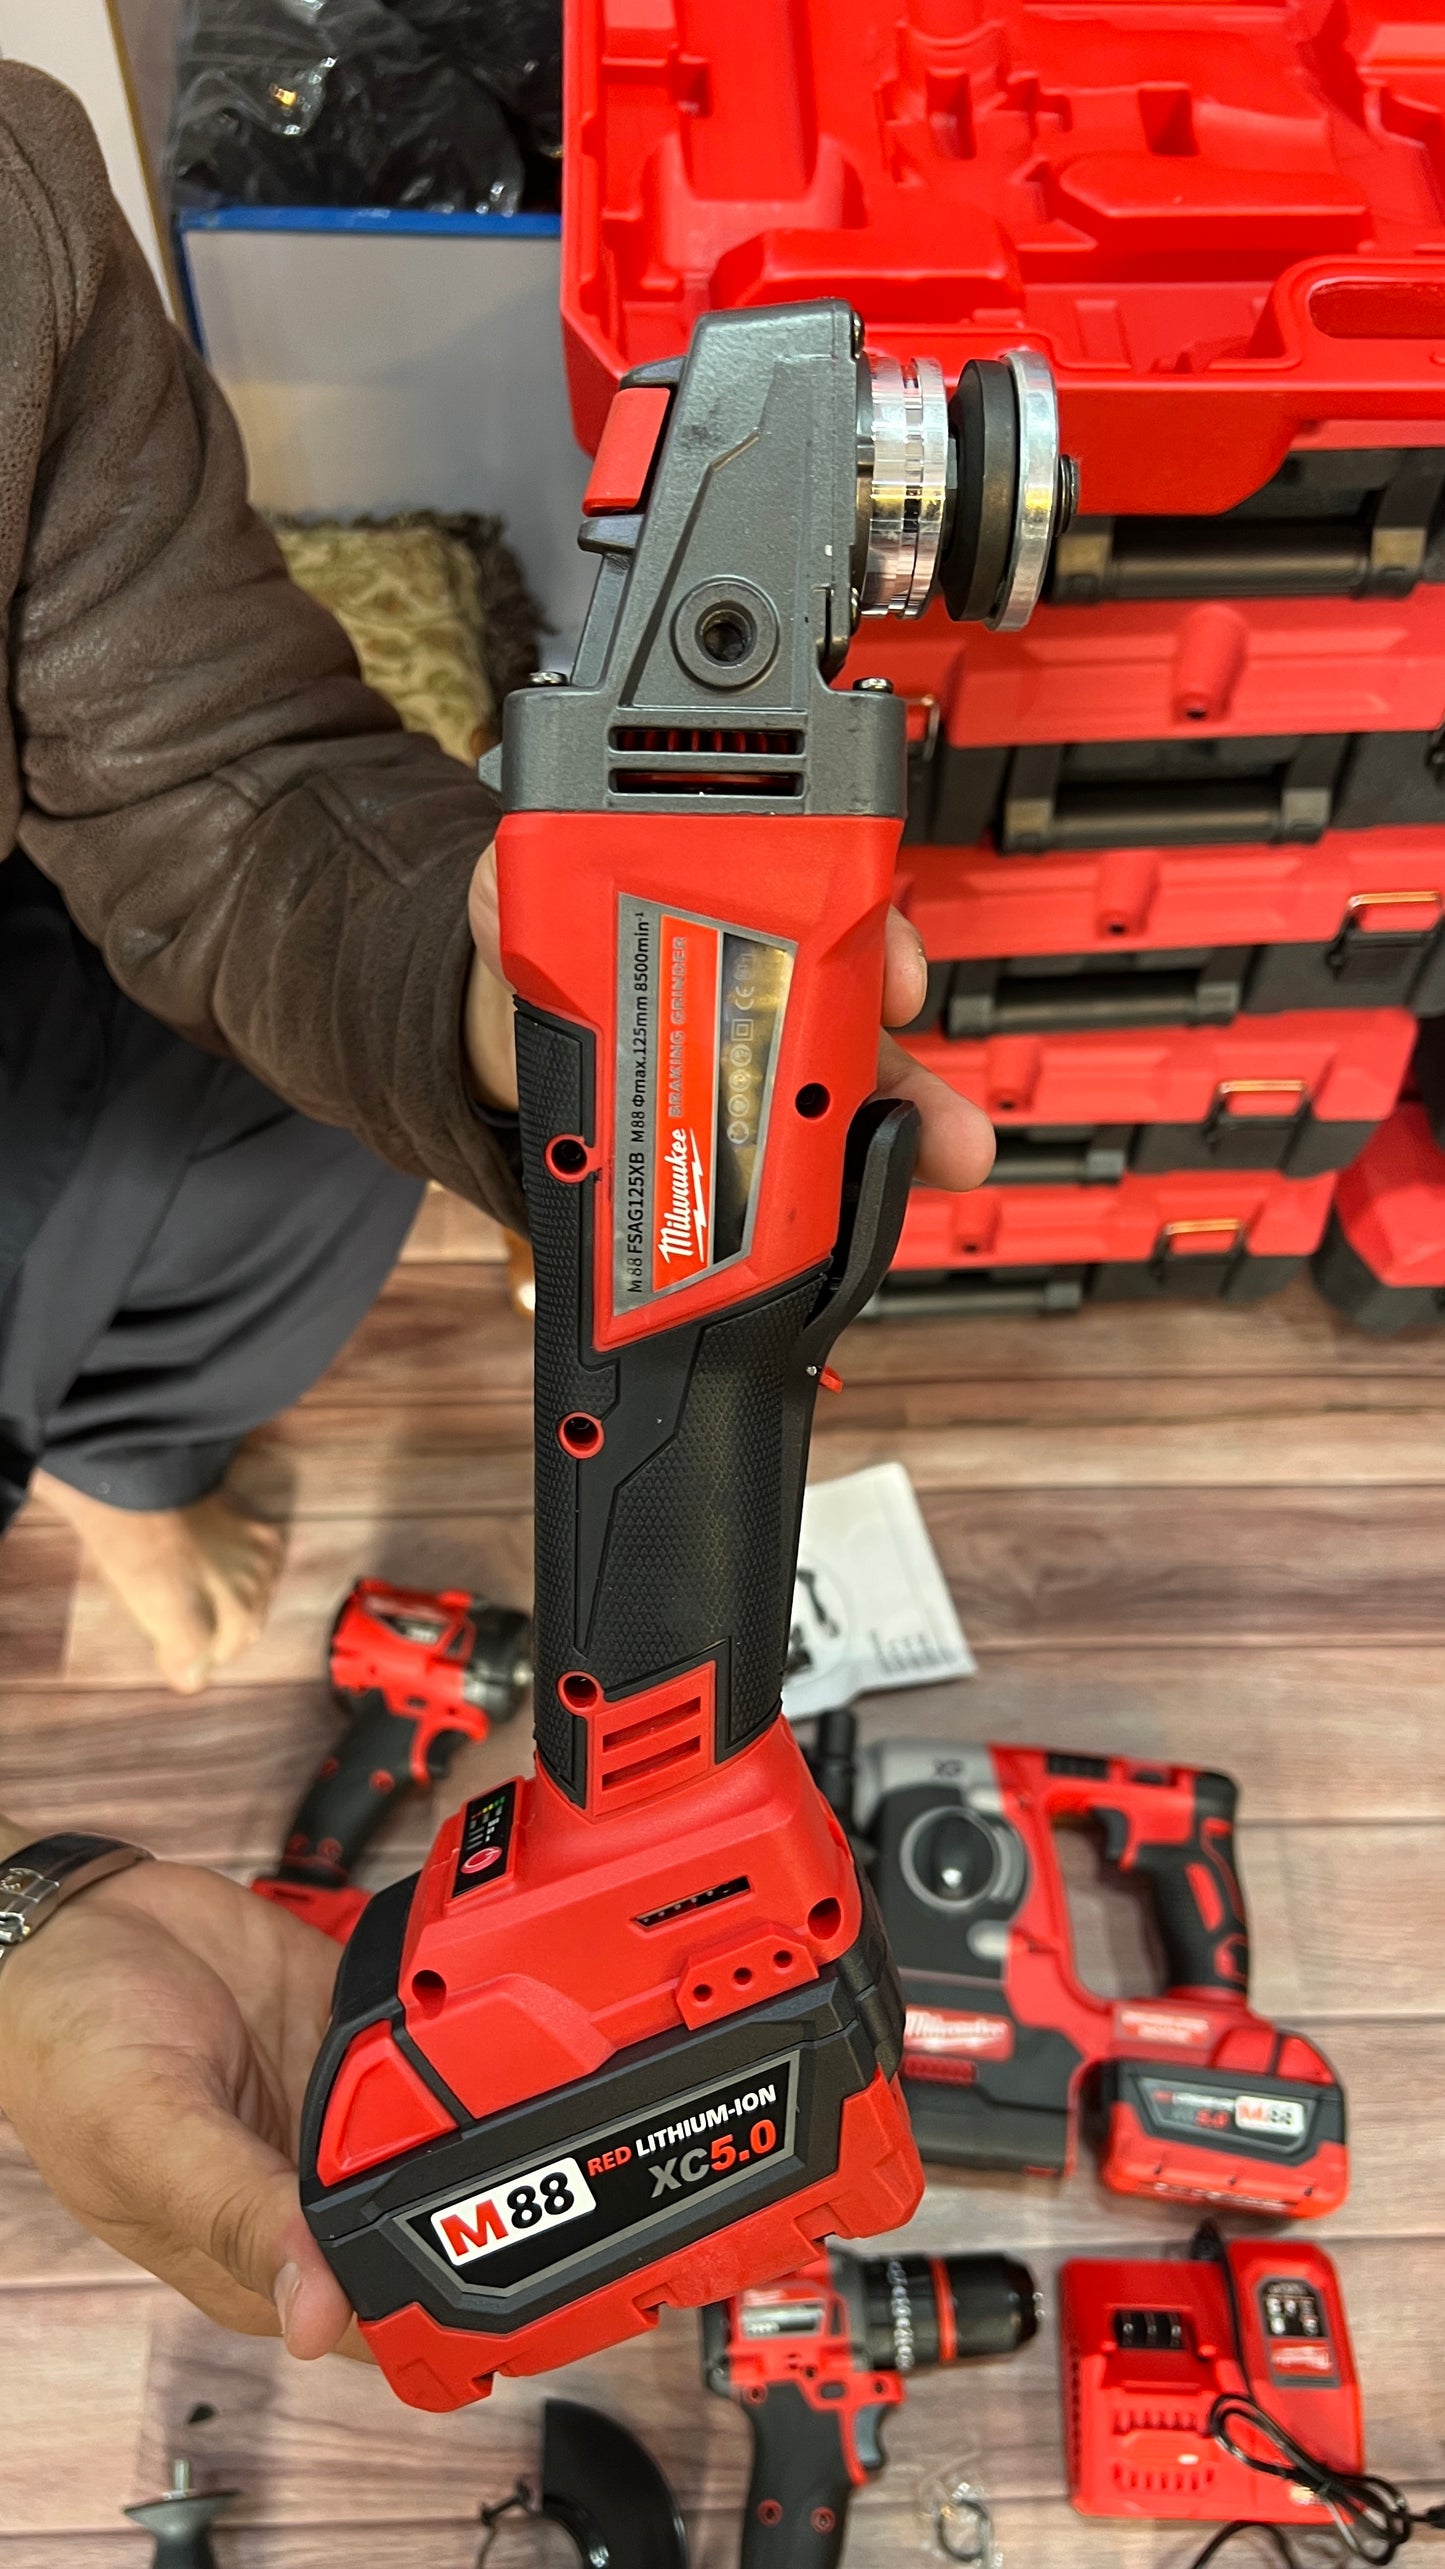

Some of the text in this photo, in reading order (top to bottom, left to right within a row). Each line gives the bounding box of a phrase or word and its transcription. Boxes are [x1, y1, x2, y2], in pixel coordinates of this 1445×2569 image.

[631, 1111, 646, 1143] M88
[658, 936, 694, 1264] Milwaukee BRAKING GRINDER
[627, 1152, 646, 1254] FSAG125XB
[587, 2083, 777, 2177] RED LITHIUM-ION
[648, 2119, 777, 2198] XC5.0
[440, 2172, 575, 2257] M88
